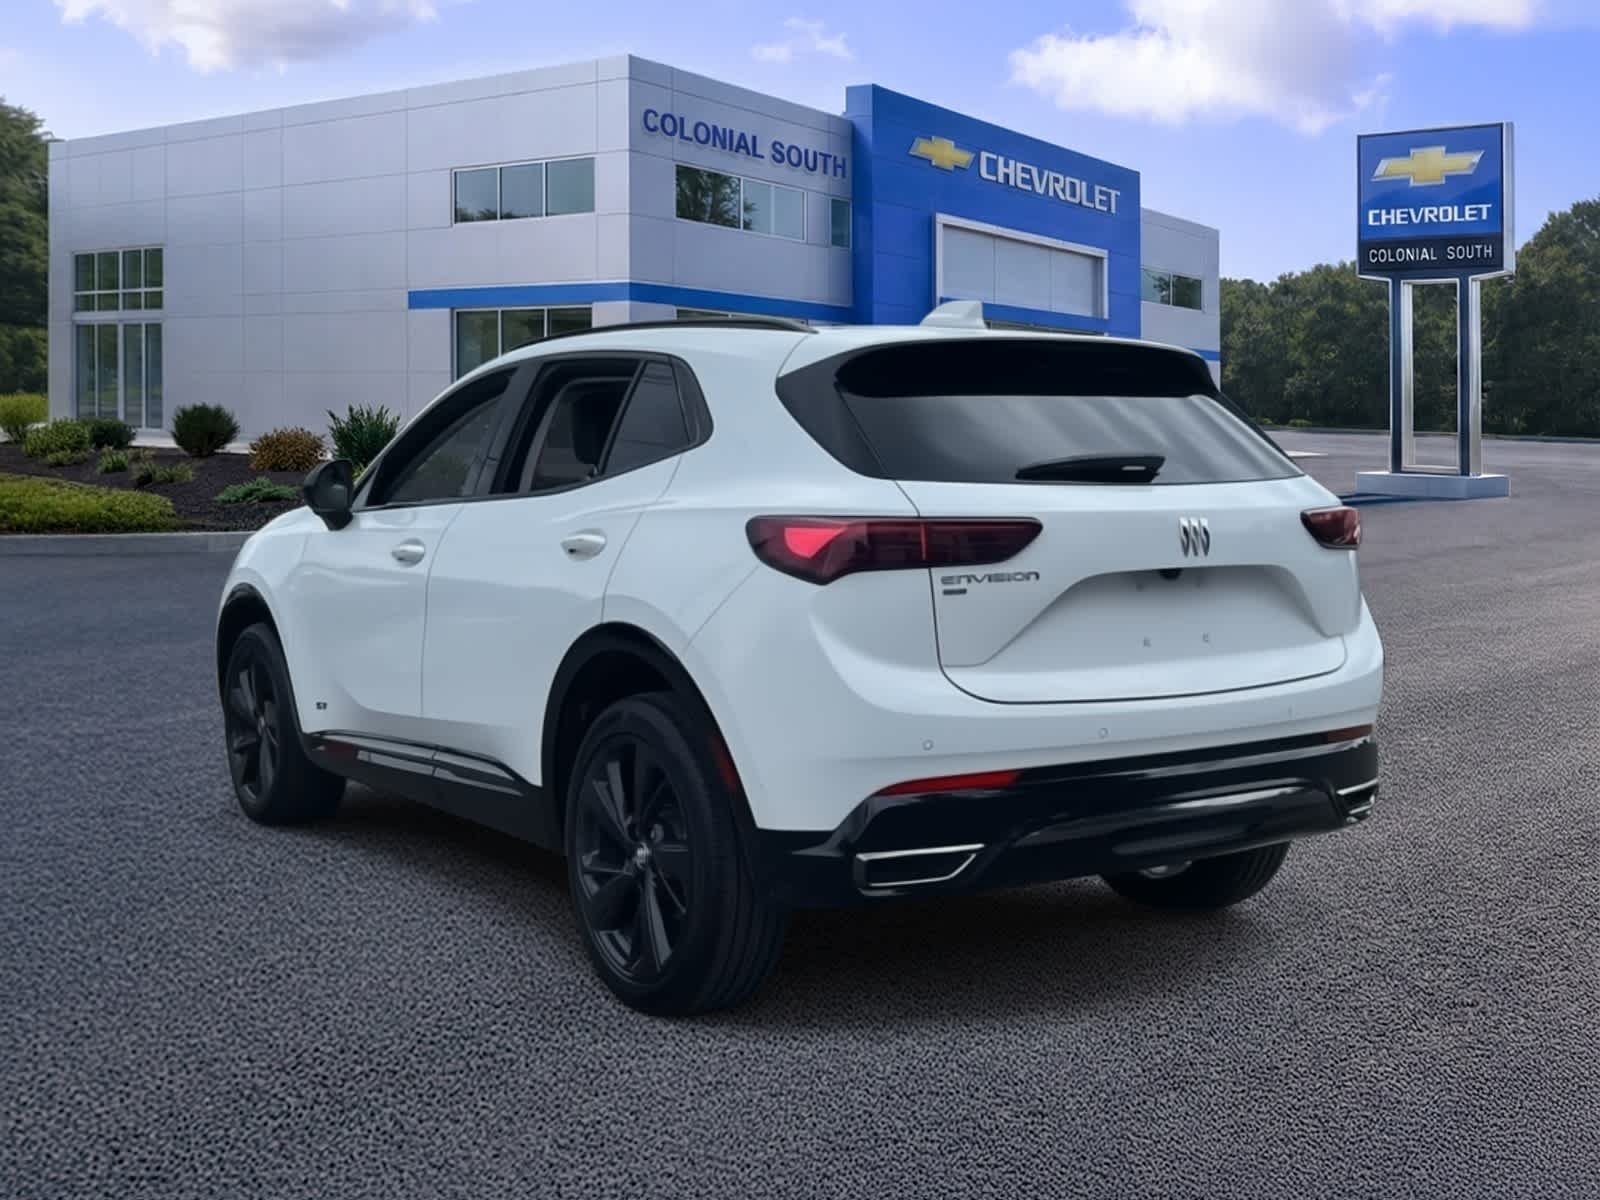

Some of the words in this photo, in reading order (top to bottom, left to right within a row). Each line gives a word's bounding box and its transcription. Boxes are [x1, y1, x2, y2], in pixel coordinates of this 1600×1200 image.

[643, 108, 765, 160] COLONIAL
[771, 140, 847, 179] SOUTH
[979, 151, 1120, 214] CHEVROLET
[1368, 204, 1492, 226] CHEVROLET
[1369, 247, 1438, 263] COLONIAL
[1447, 245, 1493, 260] SOUTH
